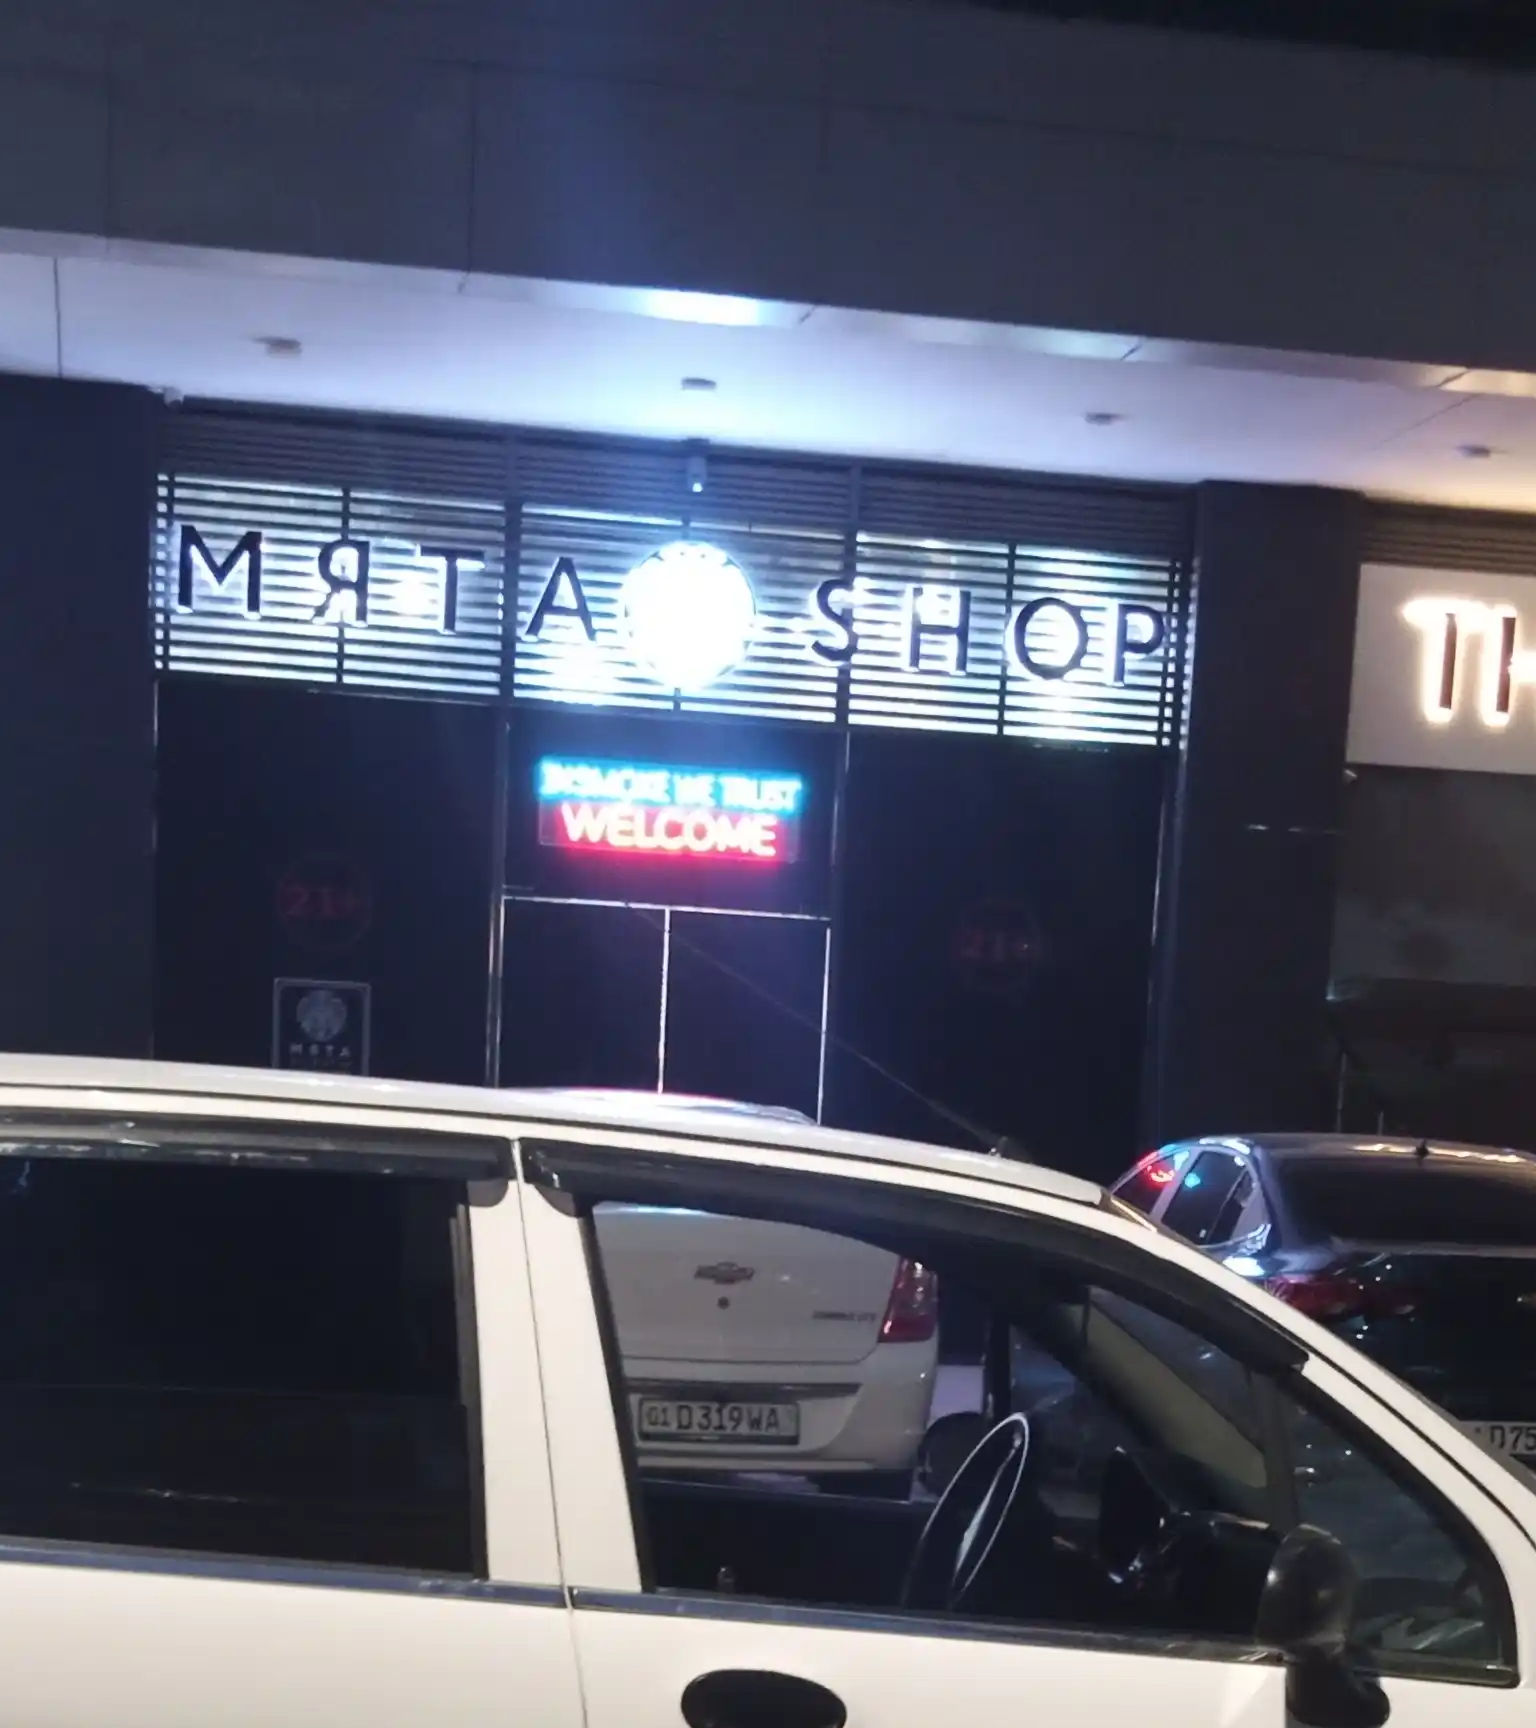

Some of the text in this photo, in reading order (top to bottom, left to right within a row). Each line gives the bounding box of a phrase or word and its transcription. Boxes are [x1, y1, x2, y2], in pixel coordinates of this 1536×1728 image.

[176, 524, 1167, 686] МЯТА SHOP
[561, 801, 776, 857] WELCOME
